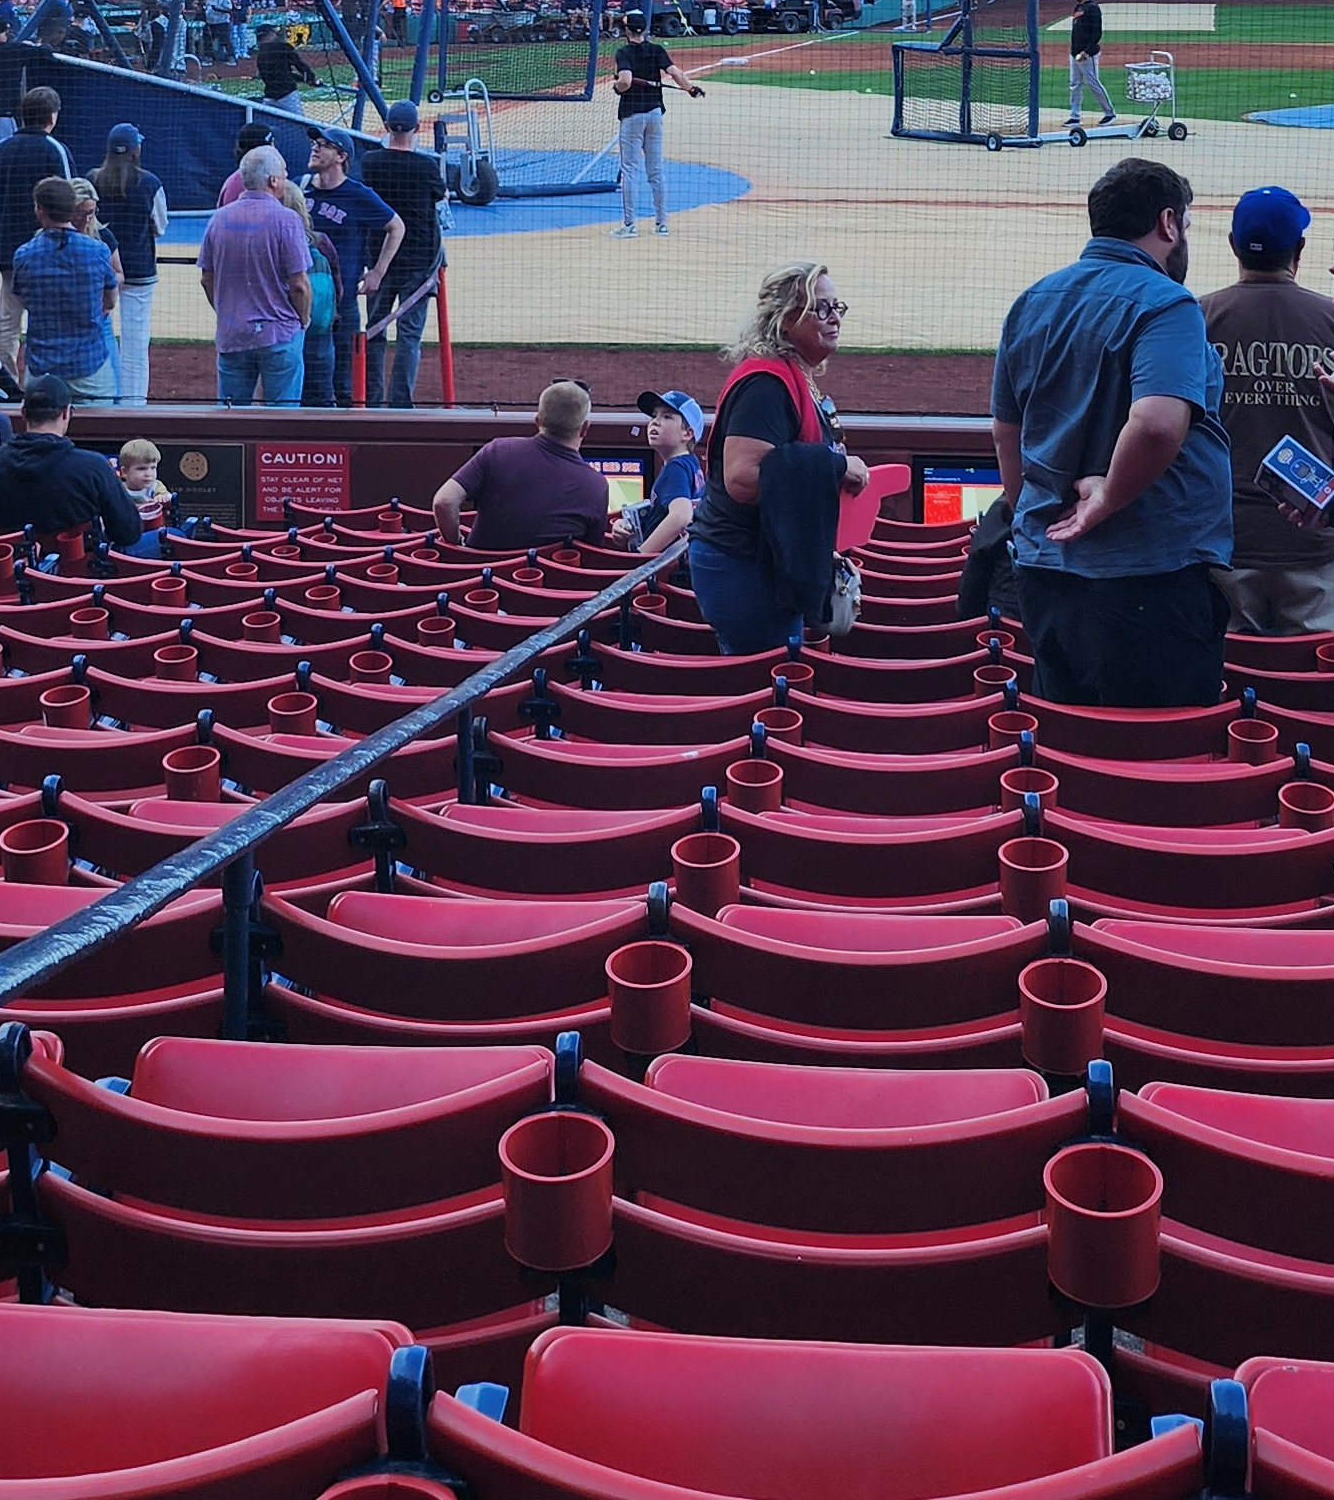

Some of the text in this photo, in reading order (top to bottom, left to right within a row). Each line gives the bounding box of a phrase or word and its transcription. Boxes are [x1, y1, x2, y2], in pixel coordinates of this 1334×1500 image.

[1253, 379, 1296, 394] OVER
[1224, 391, 1321, 407] EVERYTHING
[260, 452, 344, 465] CAUTION!
